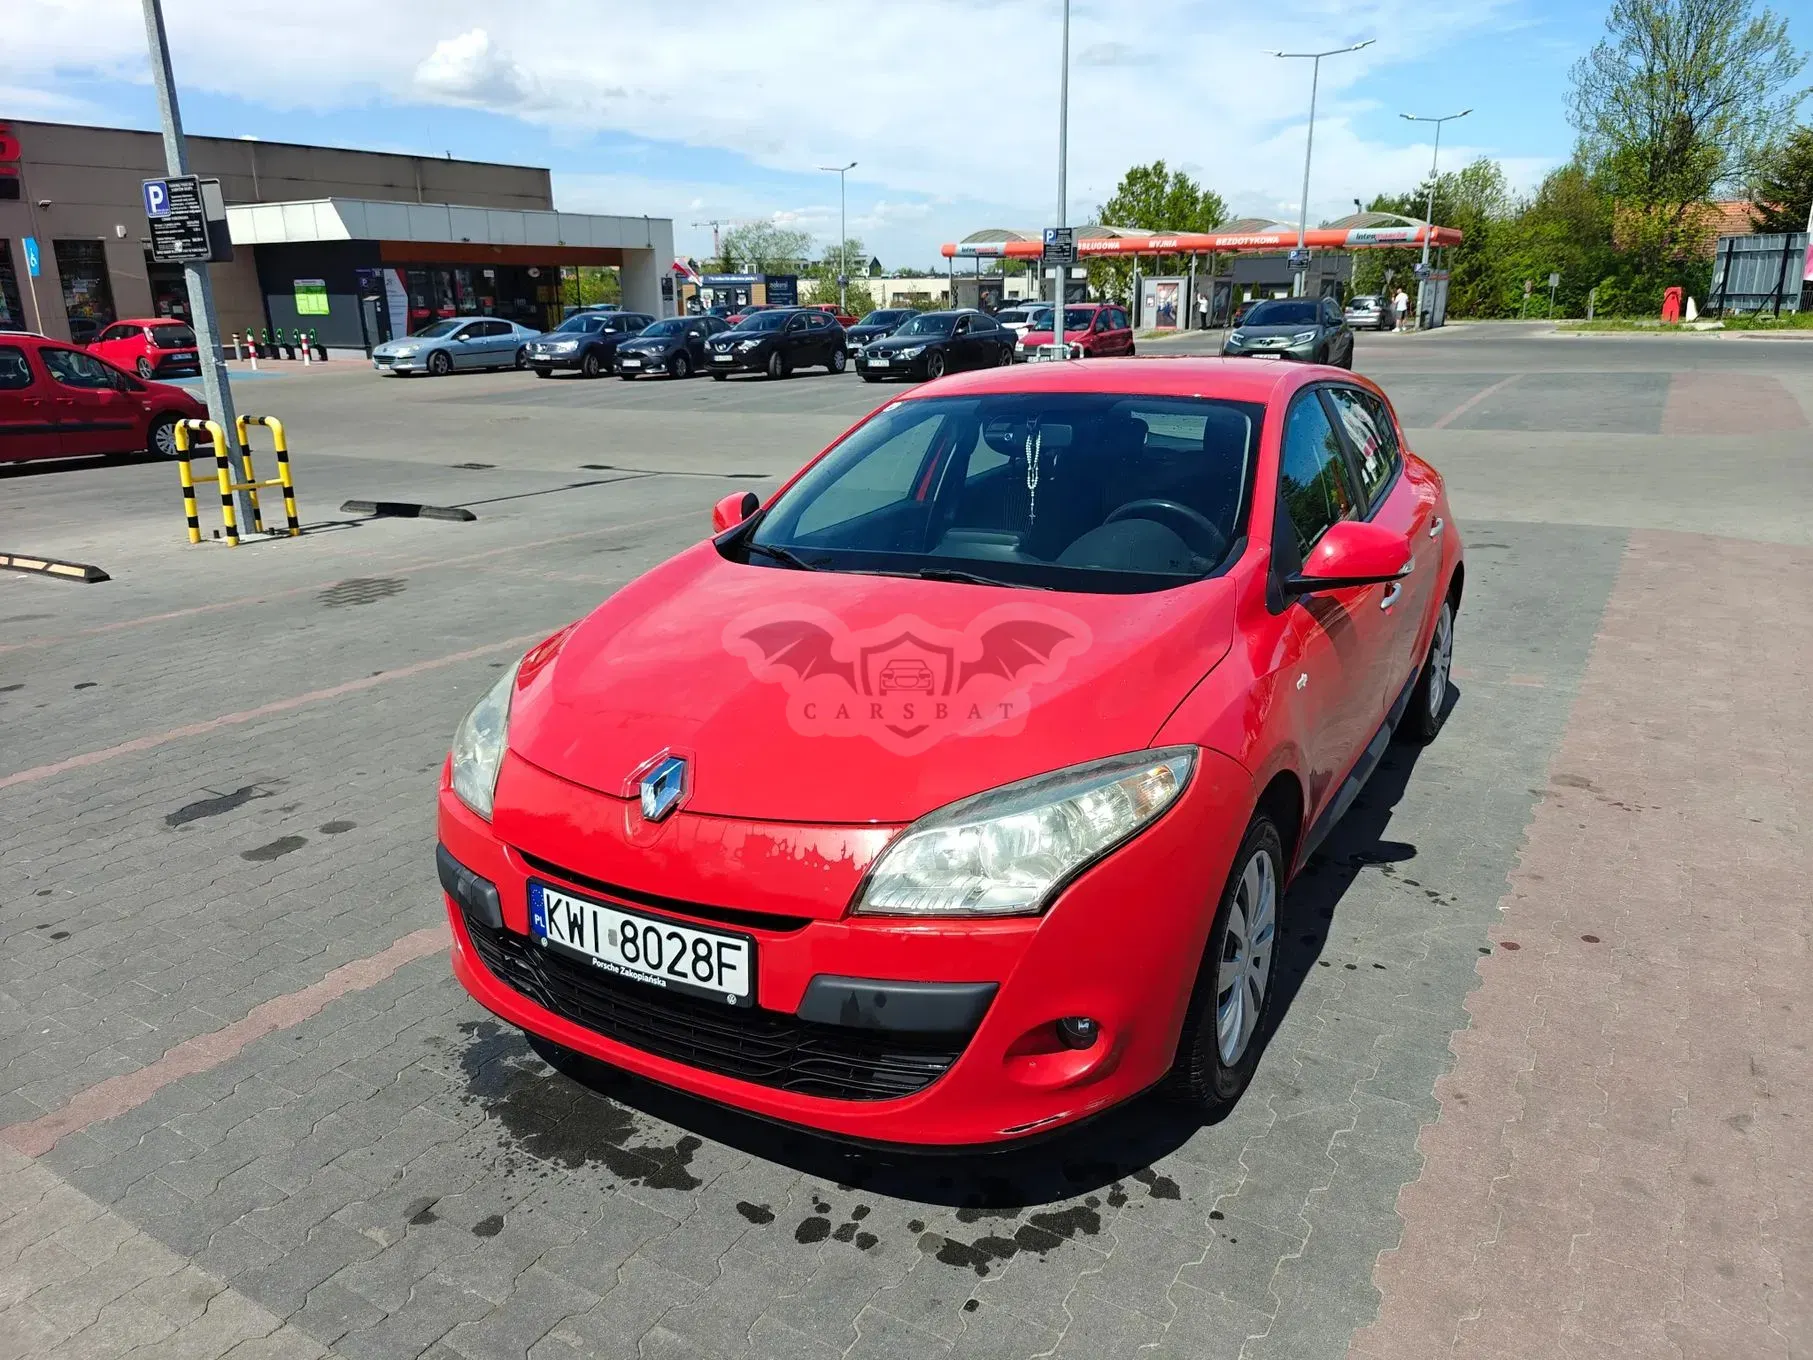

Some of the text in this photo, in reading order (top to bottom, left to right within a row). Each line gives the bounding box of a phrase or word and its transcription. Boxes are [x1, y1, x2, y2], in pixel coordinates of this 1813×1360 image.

[148, 185, 163, 212] P
[1046, 230, 1054, 242] P
[1078, 236, 1280, 250] BSŁUGOWA MYJNIA BEZDOTYKOWA
[534, 914, 546, 929] PL
[546, 893, 742, 987] KWI 8028F
[592, 957, 667, 987] Porsche Zakopiańska
